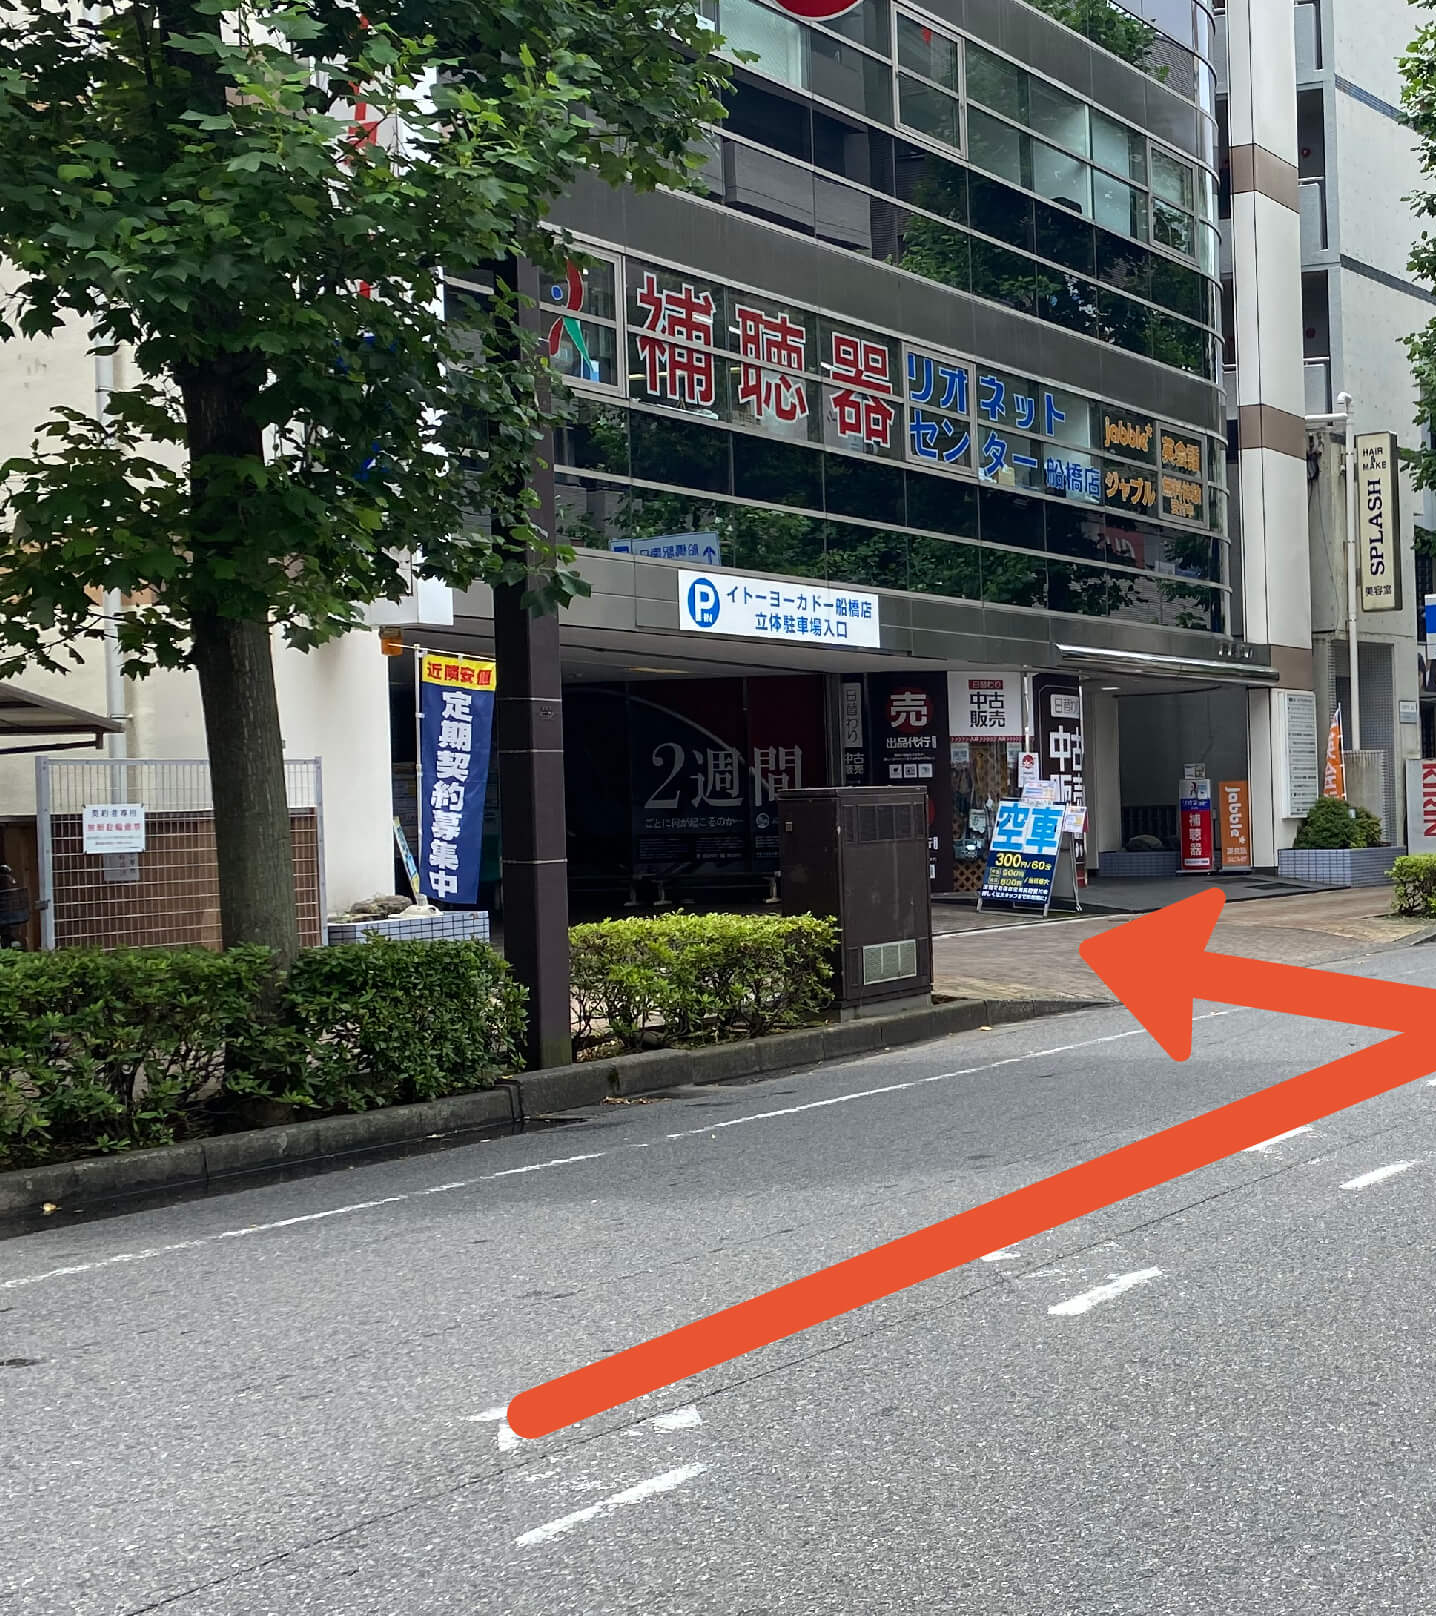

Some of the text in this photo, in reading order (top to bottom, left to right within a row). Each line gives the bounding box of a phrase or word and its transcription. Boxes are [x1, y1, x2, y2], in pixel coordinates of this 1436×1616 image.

[636, 271, 895, 450] 補聴器
[906, 351, 1066, 437] リオネット
[908, 410, 1039, 479] センター
[1362, 447, 1383, 457] HAIR
[1045, 457, 1101, 499] 船橋店
[1362, 461, 1387, 471] MAKE
[1104, 471, 1156, 507] ジャブル
[1367, 478, 1385, 576] SPLASH
[693, 583, 716, 622] P
[726, 585, 873, 619] イトーヨーカドー船橋店
[1365, 585, 1392, 597] 美容室
[755, 612, 849, 639] 立体駐車場入口
[890, 691, 928, 728] 売
[969, 691, 1005, 710] 中古
[969, 710, 1006, 728] 販売
[1053, 697, 1080, 714] 日替
[644, 742, 802, 808] 2週間
[428, 691, 474, 898] 定期契約募集中
[992, 803, 1064, 854] 空車
[1188, 812, 1202, 857] 補聴器
